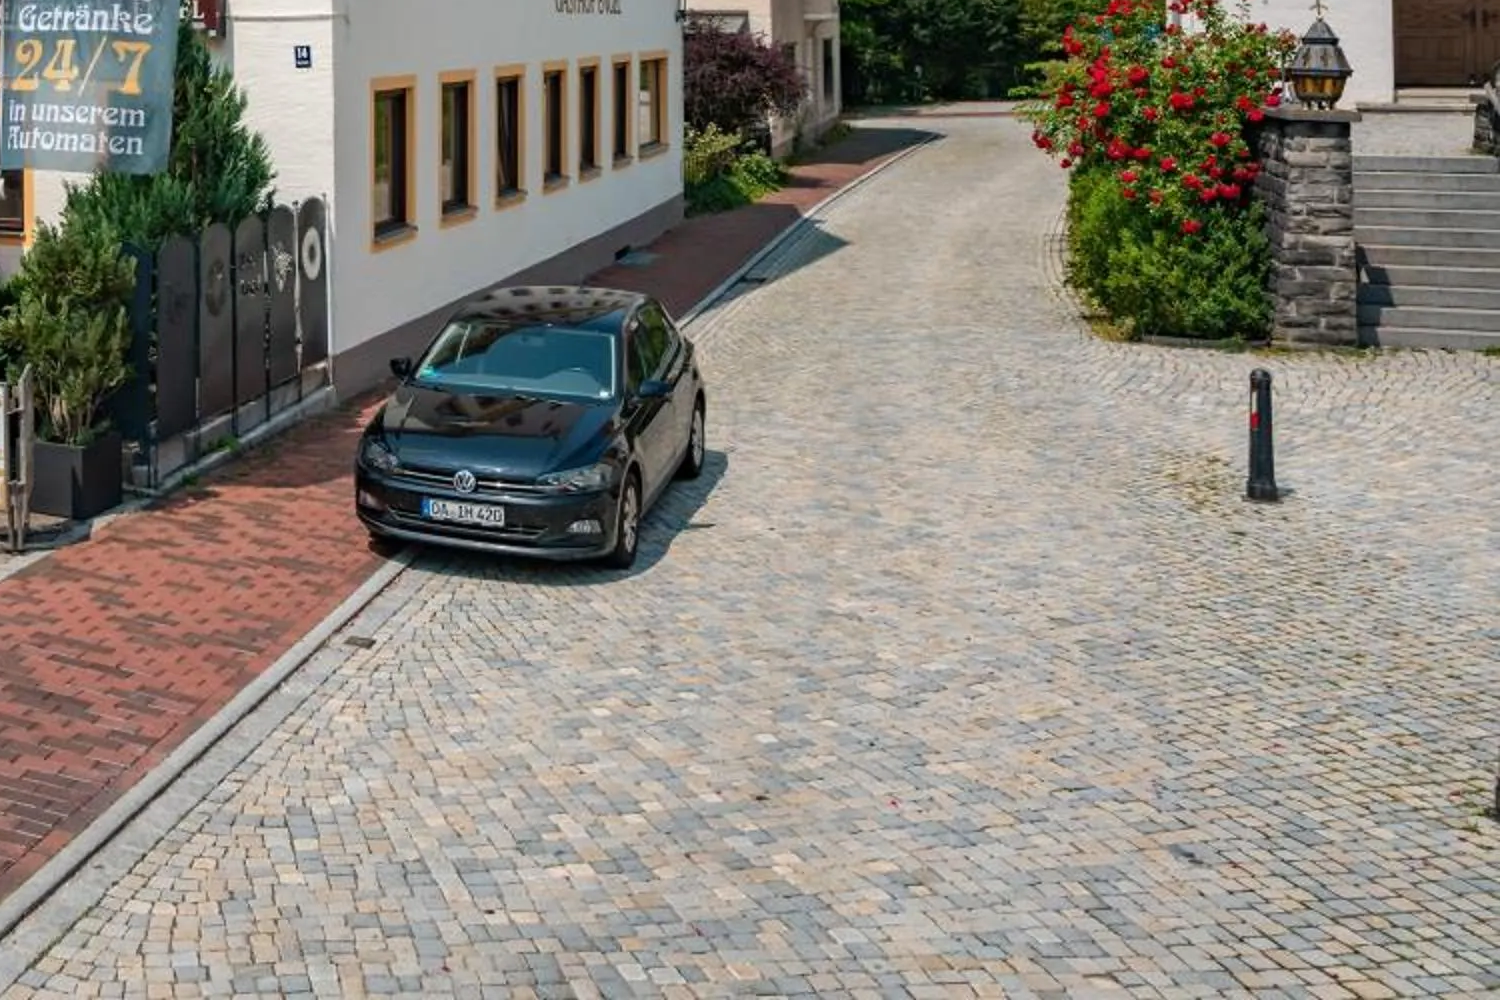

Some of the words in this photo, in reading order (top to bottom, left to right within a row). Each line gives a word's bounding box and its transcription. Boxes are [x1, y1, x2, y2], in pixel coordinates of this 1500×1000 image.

[18, 4, 154, 34] Getränke
[11, 36, 151, 95] 24/7
[31, 102, 146, 127] unserem
[7, 125, 144, 155] Automaten
